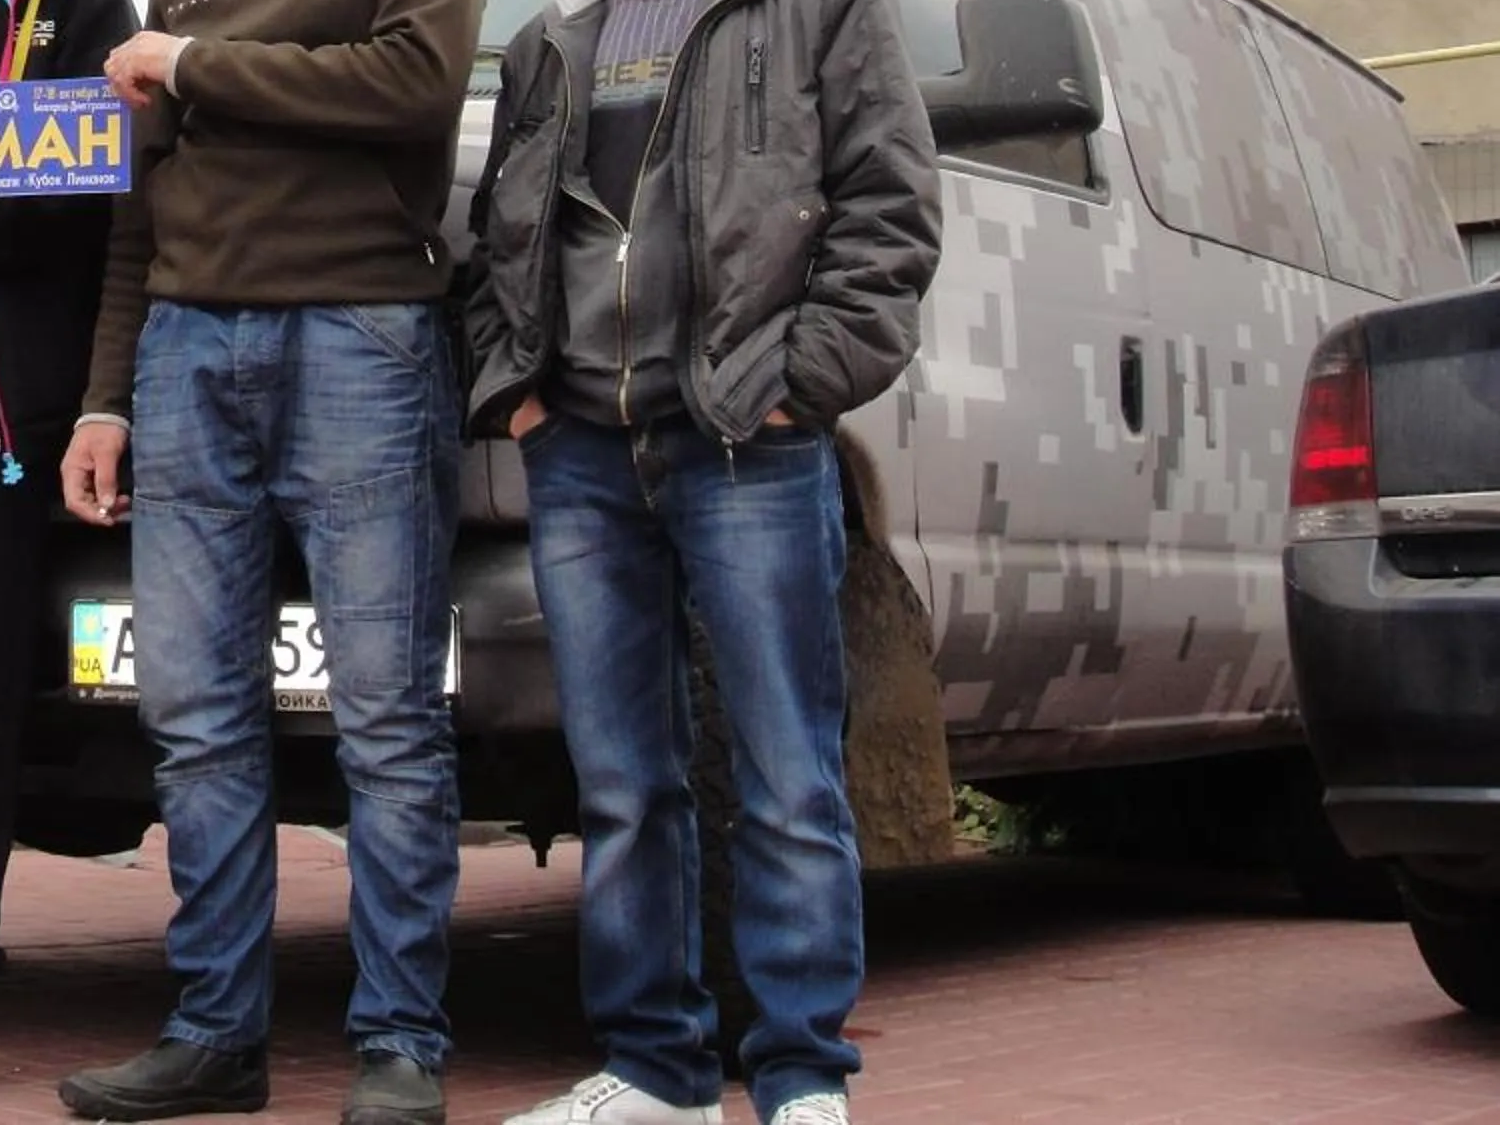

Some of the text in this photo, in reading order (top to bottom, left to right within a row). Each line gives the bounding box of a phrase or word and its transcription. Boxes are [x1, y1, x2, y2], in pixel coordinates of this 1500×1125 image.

[80, 658, 101, 672] UA
[111, 617, 325, 678] A 59
